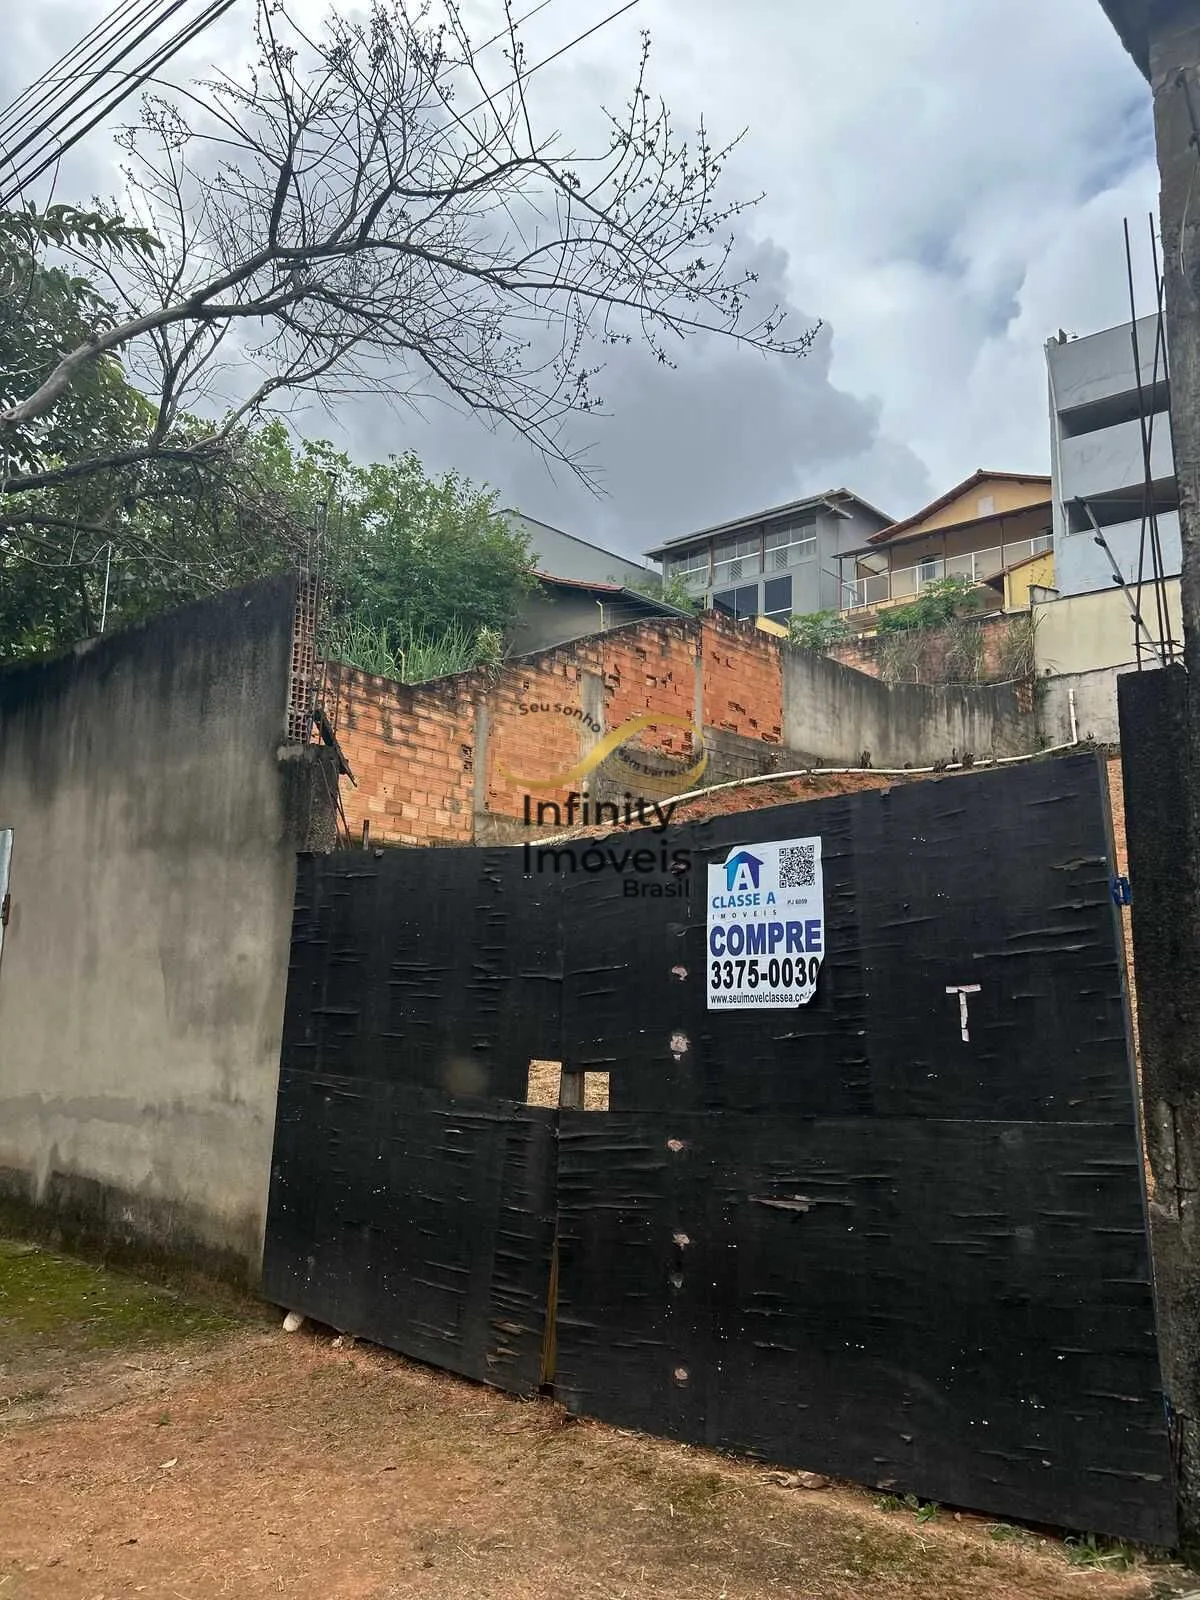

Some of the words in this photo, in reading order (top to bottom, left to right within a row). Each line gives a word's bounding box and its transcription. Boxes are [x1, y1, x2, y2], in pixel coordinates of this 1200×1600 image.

[712, 893, 761, 909] CLASSE
[766, 891, 776, 905] A
[710, 919, 822, 957] COMPRE
[711, 956, 820, 989] 3375-0030
